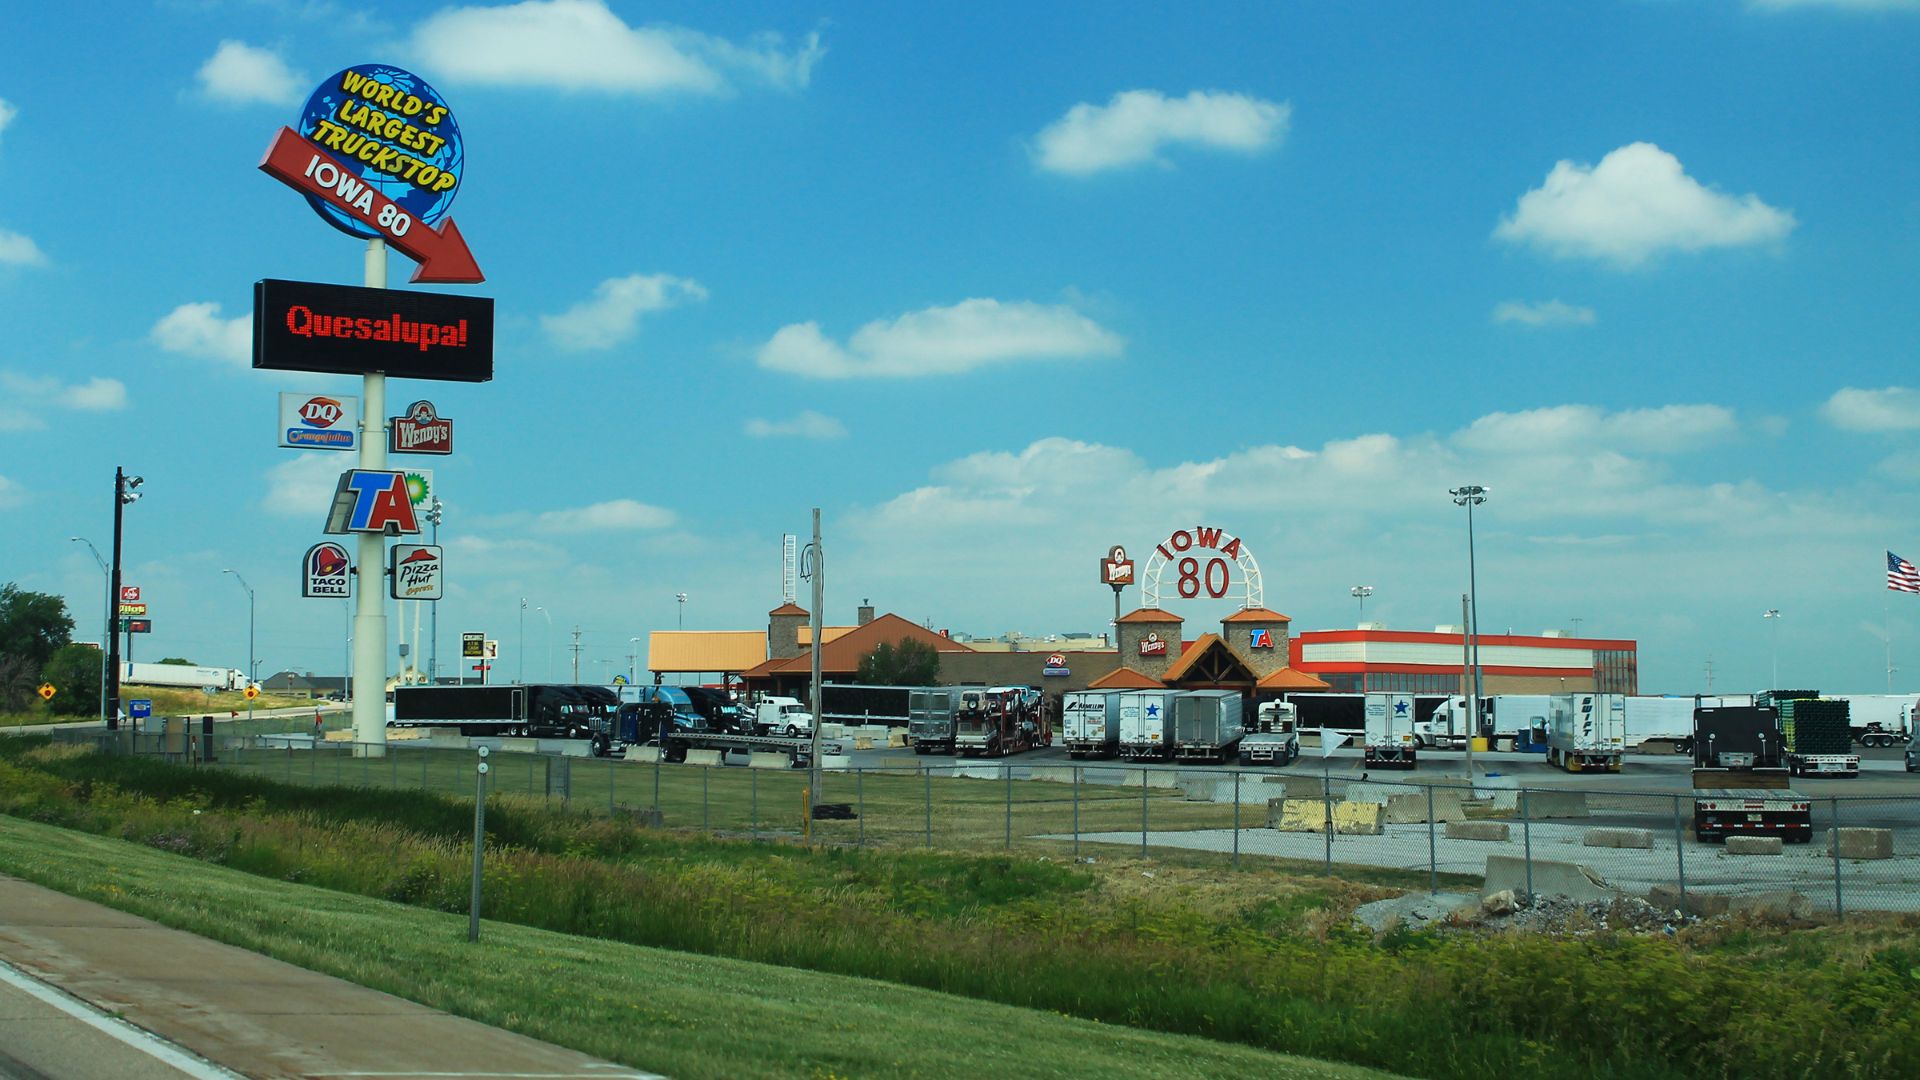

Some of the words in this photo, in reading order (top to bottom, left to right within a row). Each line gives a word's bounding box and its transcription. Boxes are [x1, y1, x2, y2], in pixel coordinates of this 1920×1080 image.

[342, 70, 447, 125] WORLD'S
[339, 99, 445, 156] LARGEST
[313, 120, 456, 192] TRUCKSTOP
[304, 154, 375, 215] IOWA
[377, 203, 411, 237] 80
[286, 305, 468, 351] Quesalupa!
[305, 403, 338, 422] DQ
[348, 470, 419, 533] TA
[1156, 525, 1241, 561] IOWA
[311, 577, 346, 586] TACO
[312, 586, 346, 594] BELL
[400, 561, 439, 582] Pizza
[406, 573, 435, 587] Hut
[1177, 557, 1230, 598] 80
[1251, 629, 1274, 647] TA
[1050, 656, 1063, 665] DQ
[1581, 697, 1593, 737] SWIFT
